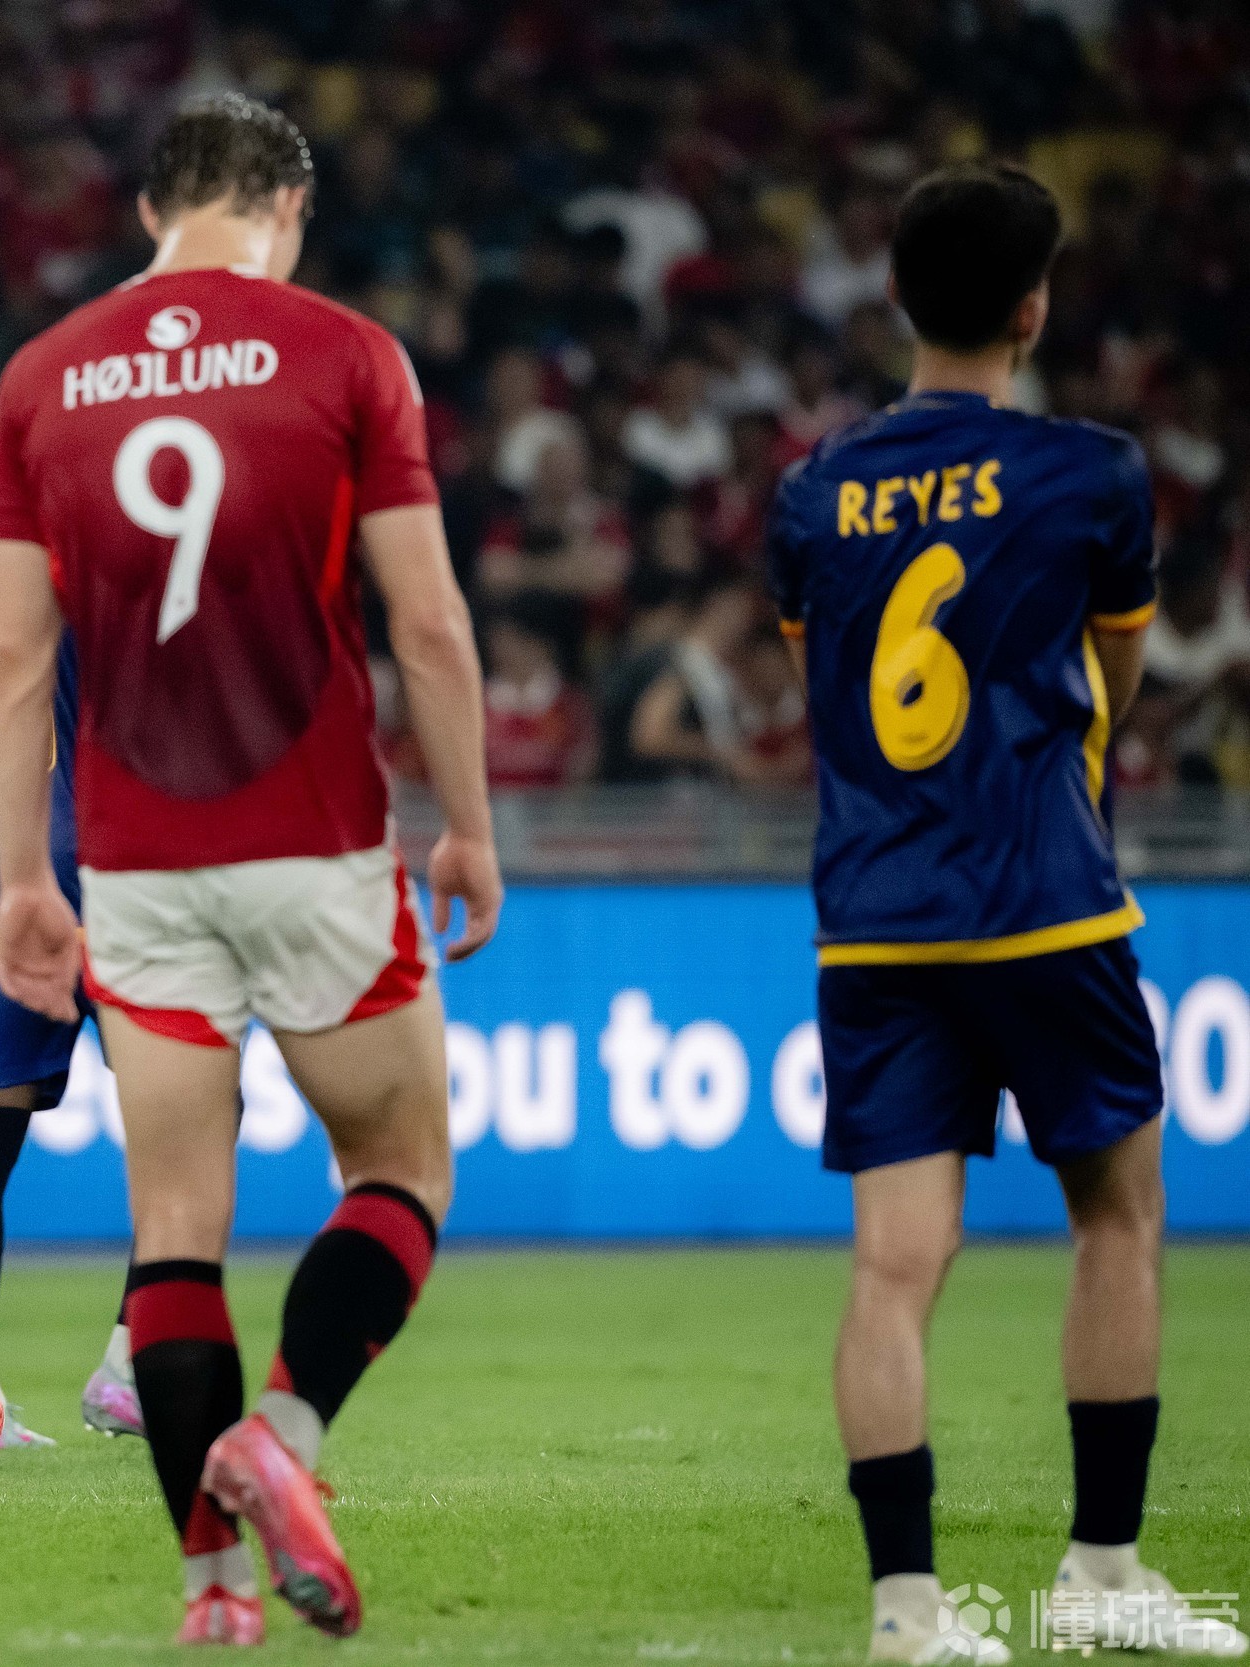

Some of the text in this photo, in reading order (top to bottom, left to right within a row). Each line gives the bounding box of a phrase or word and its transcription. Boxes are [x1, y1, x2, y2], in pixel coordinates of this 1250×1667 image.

[62, 340, 279, 410] HØJLUND
[113, 415, 226, 645] 9
[837, 459, 1002, 538] REYES
[869, 542, 971, 772] 6
[598, 987, 750, 1151] to
